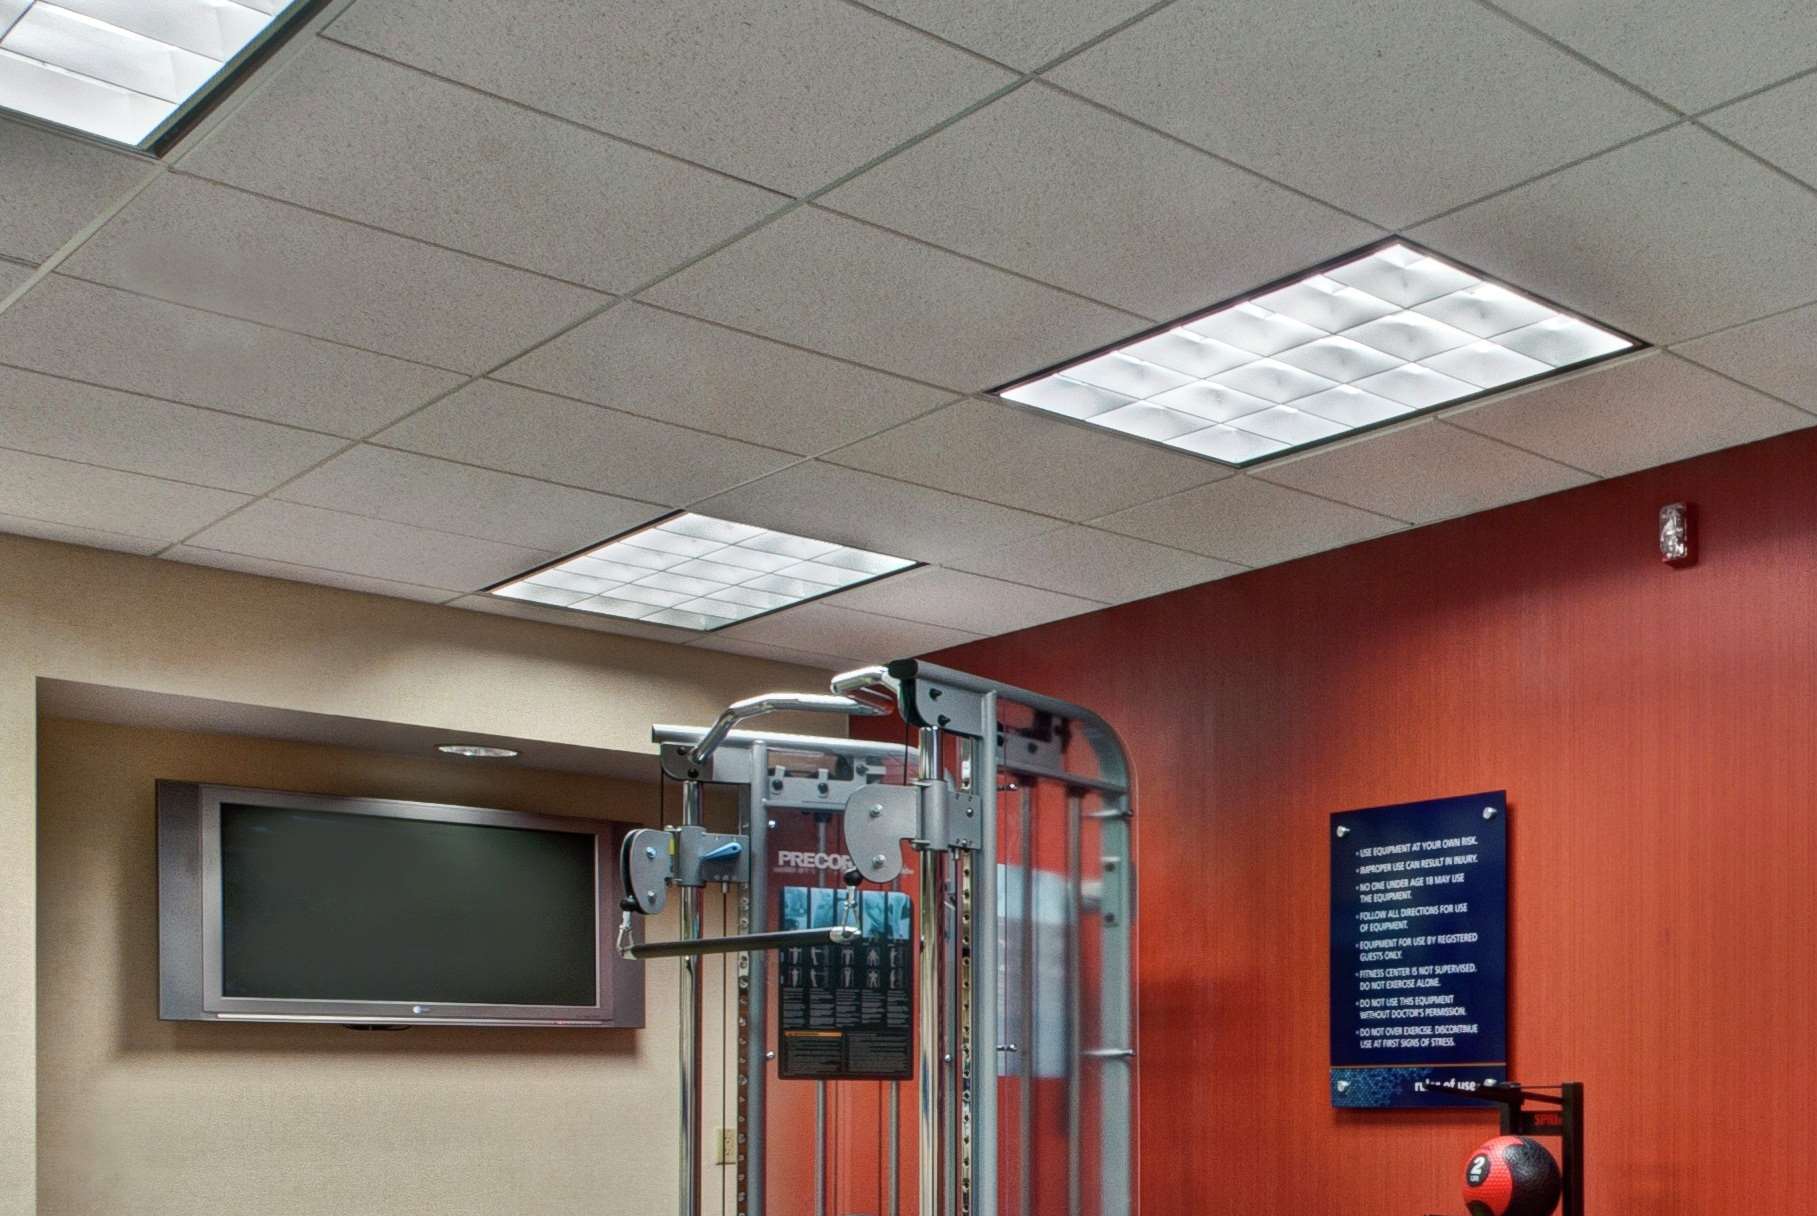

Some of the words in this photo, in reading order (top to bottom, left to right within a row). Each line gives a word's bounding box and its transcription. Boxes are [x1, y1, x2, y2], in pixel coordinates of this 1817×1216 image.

[1360, 849, 1372, 857] USE
[1374, 844, 1411, 856] EQUIPMENT
[1412, 842, 1421, 850] AT
[1422, 840, 1441, 850] YOUR
[1442, 838, 1460, 848] OWN
[1461, 836, 1478, 845] RISK.
[1360, 883, 1370, 891] NO
[1372, 882, 1385, 890] ONE
[1387, 879, 1408, 889] UNDER
[1410, 877, 1423, 886] AGE
[1426, 877, 1433, 885] 18
[1435, 875, 1450, 884] MAY
[1452, 873, 1464, 882] USE
[1360, 910, 1386, 920] FOLLOW
[1388, 909, 1399, 918] ALL
[1401, 905, 1438, 916] DIRECTIONS
[1440, 905, 1453, 913] FOR
[1455, 903, 1467, 912] USE
[1360, 938, 1397, 950] EQUIPMENT
[1398, 937, 1411, 946] FOR
[1413, 936, 1425, 945] USE
[1427, 935, 1436, 943] BY
[1438, 933, 1477, 943] REGISTERED
[1360, 969, 1384, 978] FITNESS
[1386, 967, 1410, 977] CENTER
[1412, 967, 1417, 975] IS
[1419, 966, 1433, 975] NOT
[1435, 963, 1476, 974] SUPERVISED.
[1360, 981, 1370, 990] DO
[1372, 981, 1385, 989] NOT
[1386, 979, 1415, 989] EXERCISE
[1416, 978, 1441, 987] ALONE.
[1360, 999, 1370, 1008] DO
[1372, 998, 1384, 1007] NOT
[1386, 998, 1398, 1006] USE
[1400, 997, 1413, 1006] THIS
[1415, 995, 1454, 1005] EQUIPMENT
[1360, 1028, 1370, 1036] DO
[1372, 1027, 1384, 1036] NOT
[1386, 1026, 1402, 1035] OVER
[1435, 1024, 1478, 1033] DISCONTINUE
[1360, 1040, 1372, 1048] USE
[1373, 1039, 1382, 1048] AT
[1383, 1039, 1399, 1048] FIRST
[1401, 1038, 1419, 1047] SIGNS
[1421, 1038, 1430, 1046] OF
[1431, 1038, 1455, 1047] STRESS.
[1457, 1081, 1476, 1092] use
[1470, 1156, 1485, 1175] 2
